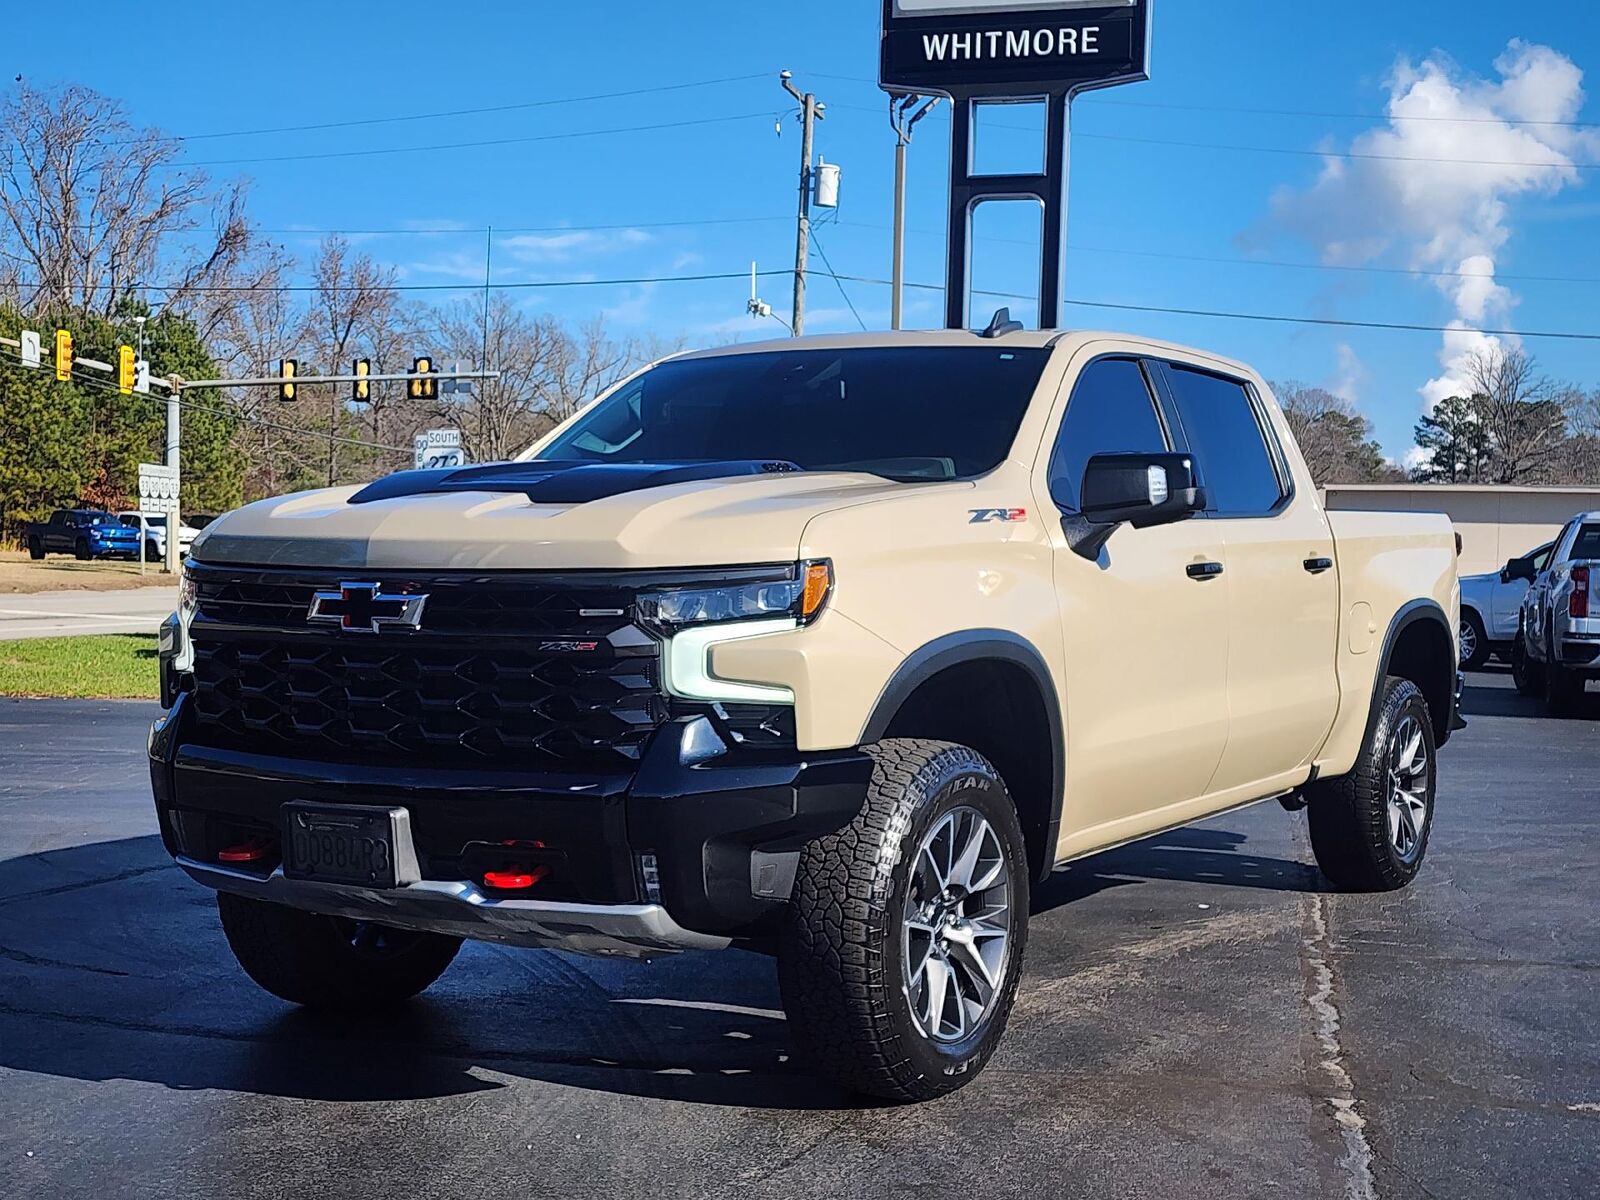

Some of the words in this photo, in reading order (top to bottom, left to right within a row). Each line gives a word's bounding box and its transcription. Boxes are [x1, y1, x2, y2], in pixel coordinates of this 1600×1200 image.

[922, 26, 1100, 61] WHITMORE
[429, 432, 458, 443] SOUTH
[967, 508, 1027, 525] ZR2
[537, 641, 599, 651] ZR2
